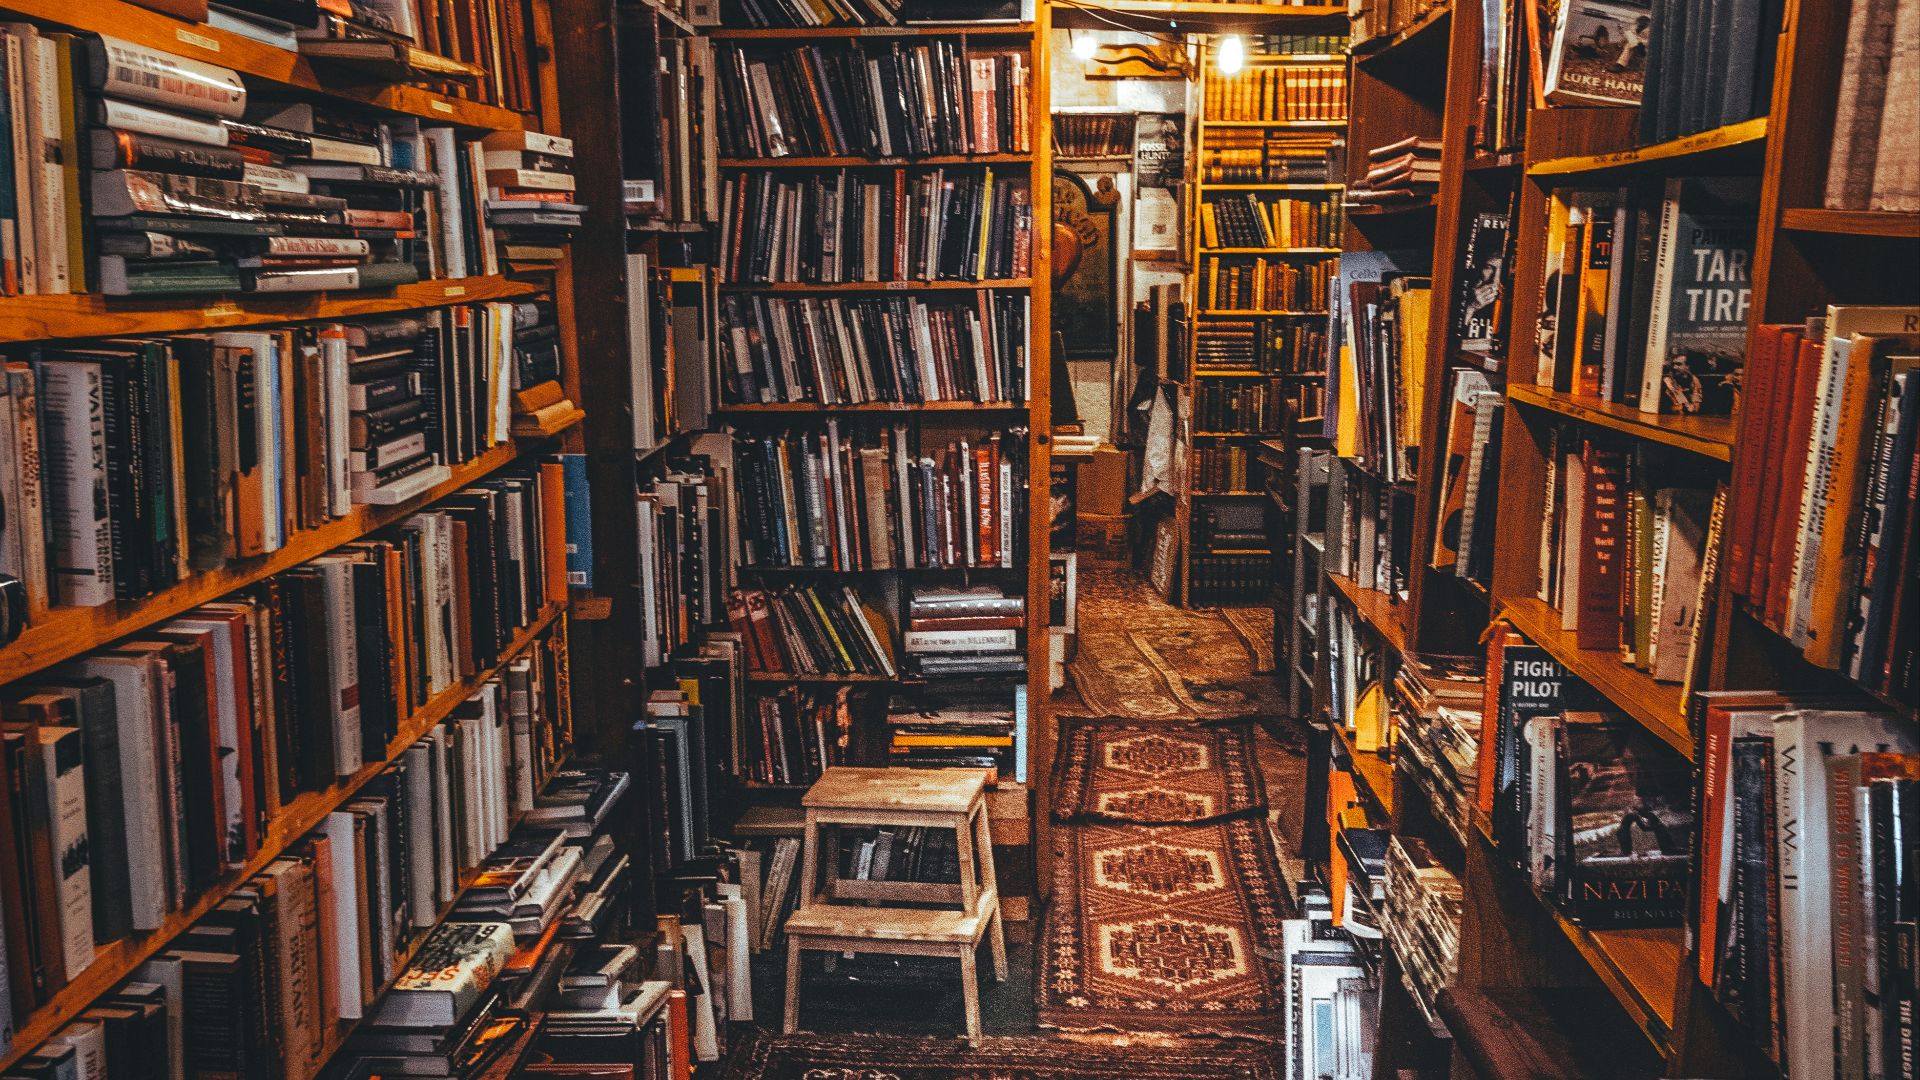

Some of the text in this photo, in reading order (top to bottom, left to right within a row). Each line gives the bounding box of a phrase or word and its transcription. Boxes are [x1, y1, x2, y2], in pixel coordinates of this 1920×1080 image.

[1563, 72, 1600, 87] LUKE
[1658, 231, 1669, 268] TIRPITZ
[1349, 269, 1378, 280] Cello
[1826, 350, 1840, 407] Einsatz
[89, 385, 103, 472] VALLEY
[1818, 445, 1835, 536] und Notfall
[1829, 451, 1842, 504] PEACE
[1865, 476, 1875, 507] World
[910, 637, 924, 646] ART
[1511, 681, 1563, 698] PILOT
[1706, 749, 1717, 798] MEADOW
[1782, 745, 1798, 889] WORLD WAR II
[1835, 767, 1850, 834] WITNESS
[1837, 843, 1850, 860] TO
[1582, 880, 1648, 901] NAZI
[1837, 865, 1851, 917] WORLD
[1899, 999, 1914, 1080] THE DELUGE
